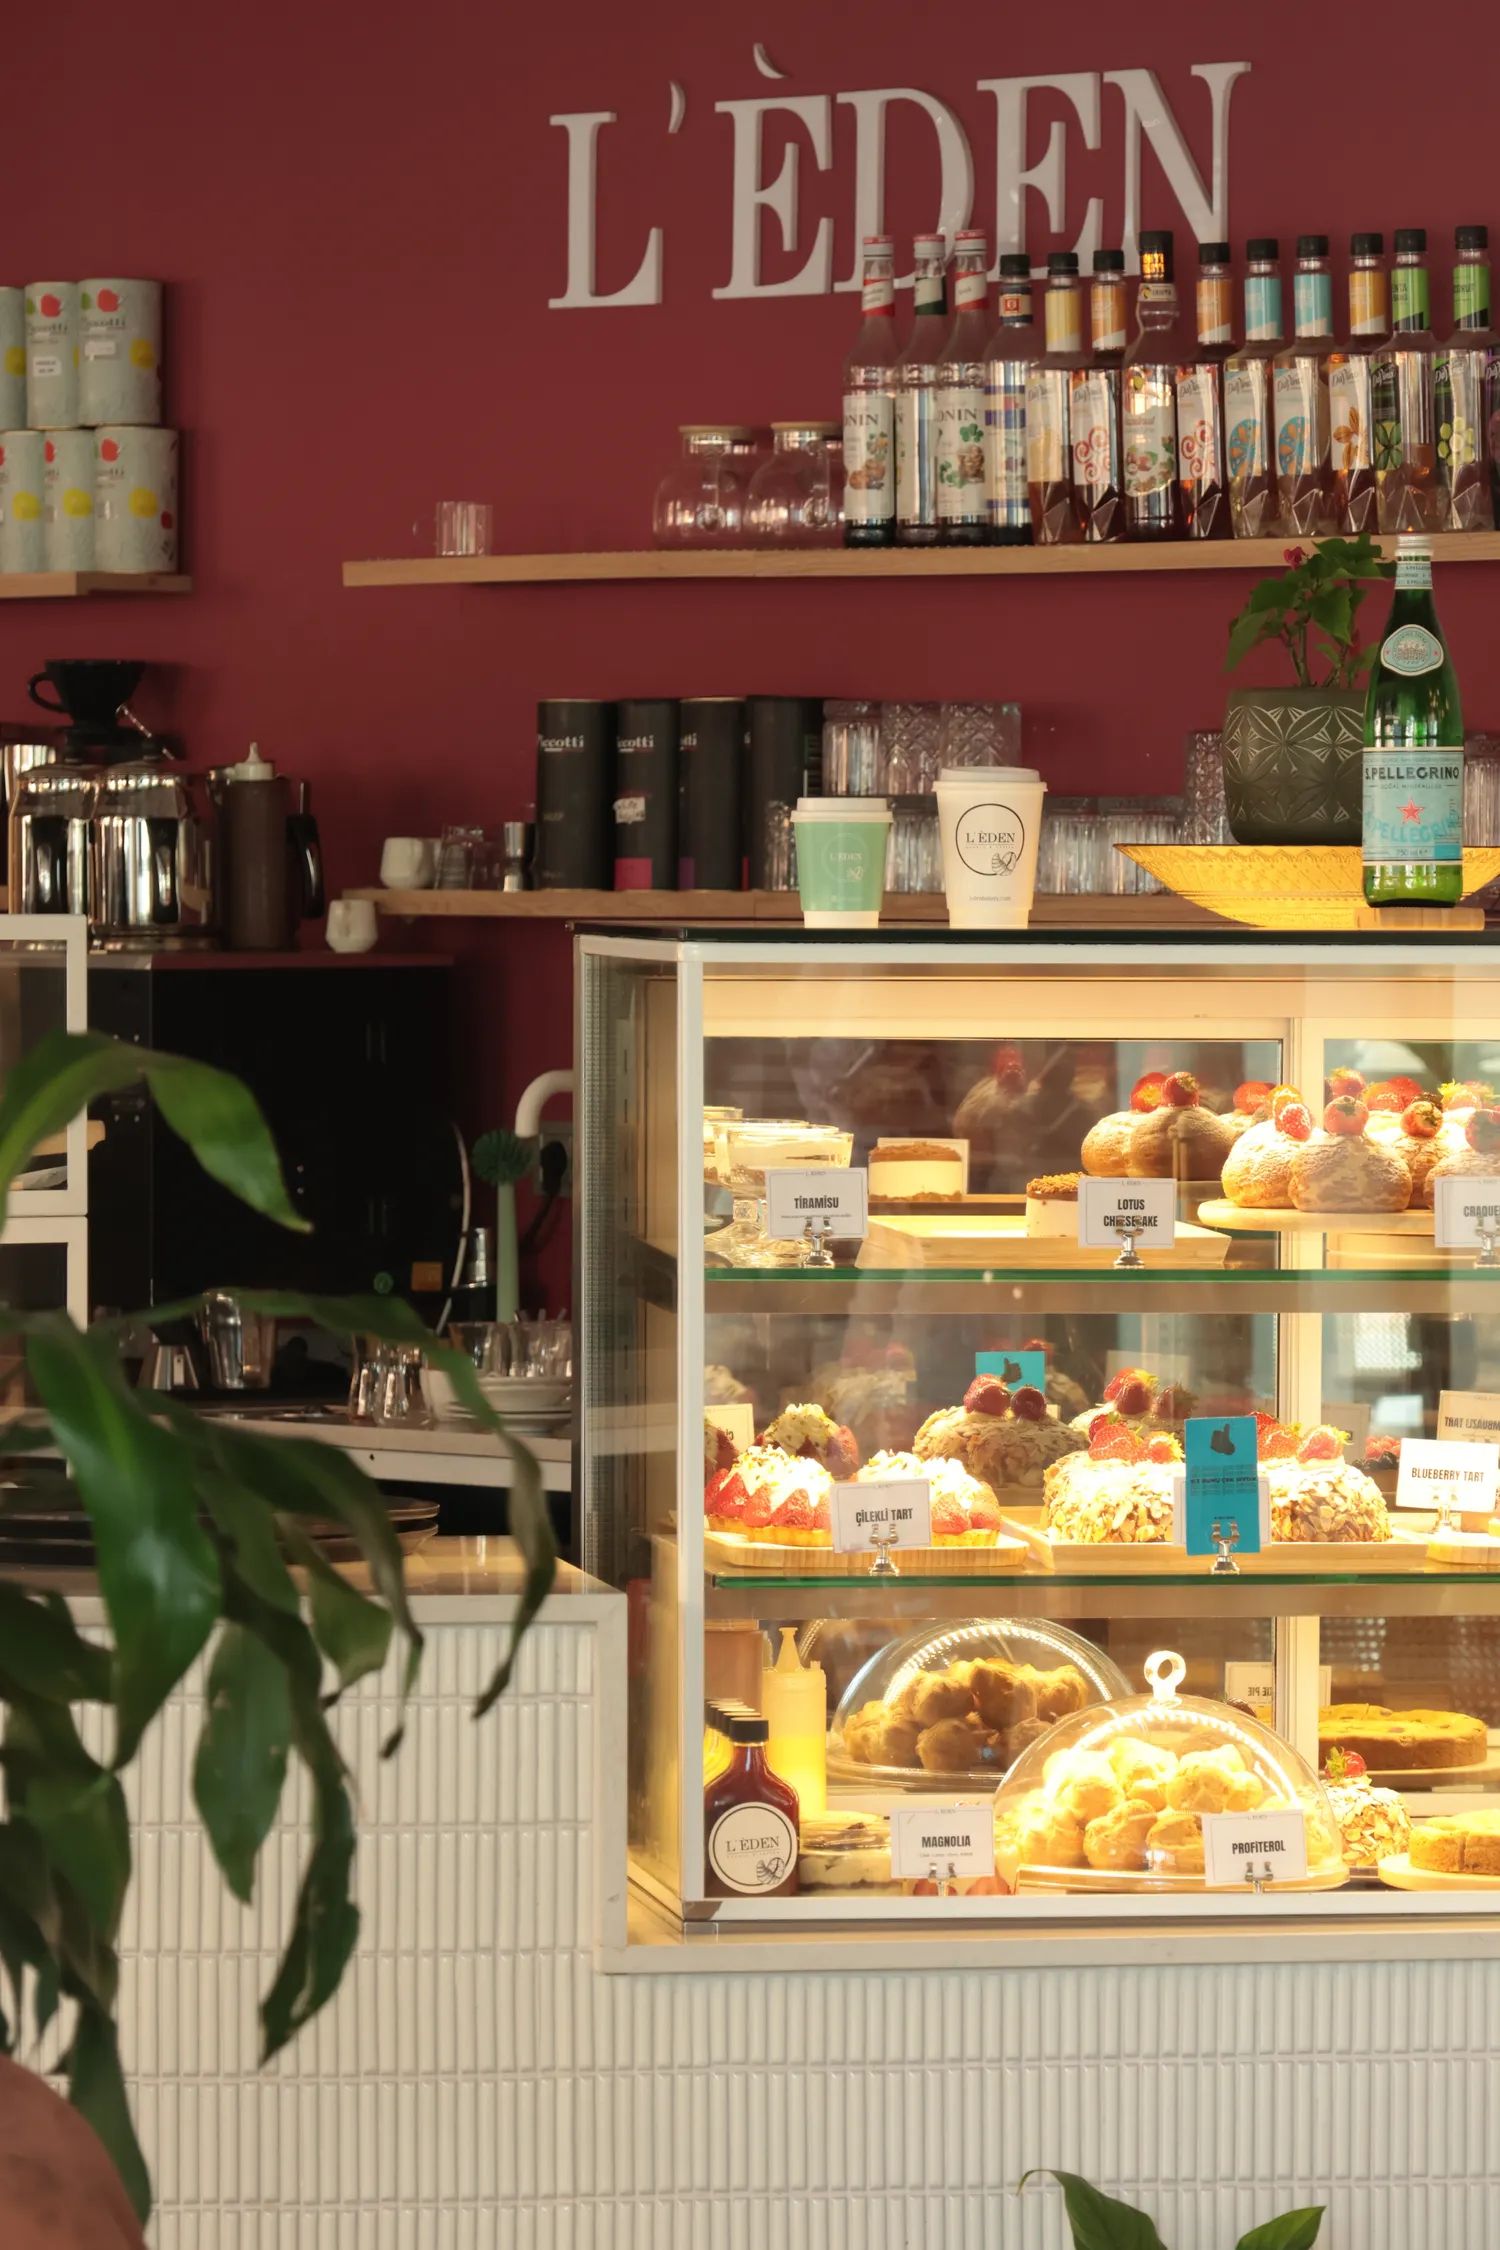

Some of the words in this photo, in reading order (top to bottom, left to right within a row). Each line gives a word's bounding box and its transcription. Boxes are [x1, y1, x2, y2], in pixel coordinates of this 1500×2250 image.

[844, 413, 879, 426] NIN
[937, 408, 978, 423] ONIN
[1365, 766, 1460, 780] S.PELLEGRINO
[793, 1194, 840, 1209] TİRAMİSU
[1117, 1198, 1145, 1211] LOTUS
[1103, 1214, 1158, 1227] CHESEAKE
[1411, 1467, 1460, 1481] BLUEBERRY
[1463, 1470, 1485, 1483] TART
[855, 1508, 889, 1527] ÇİLEKLİ
[891, 1508, 914, 1521] TART
[921, 1834, 972, 1849] MAGNOLIA
[1231, 1839, 1287, 1855] PROFİTEROL
